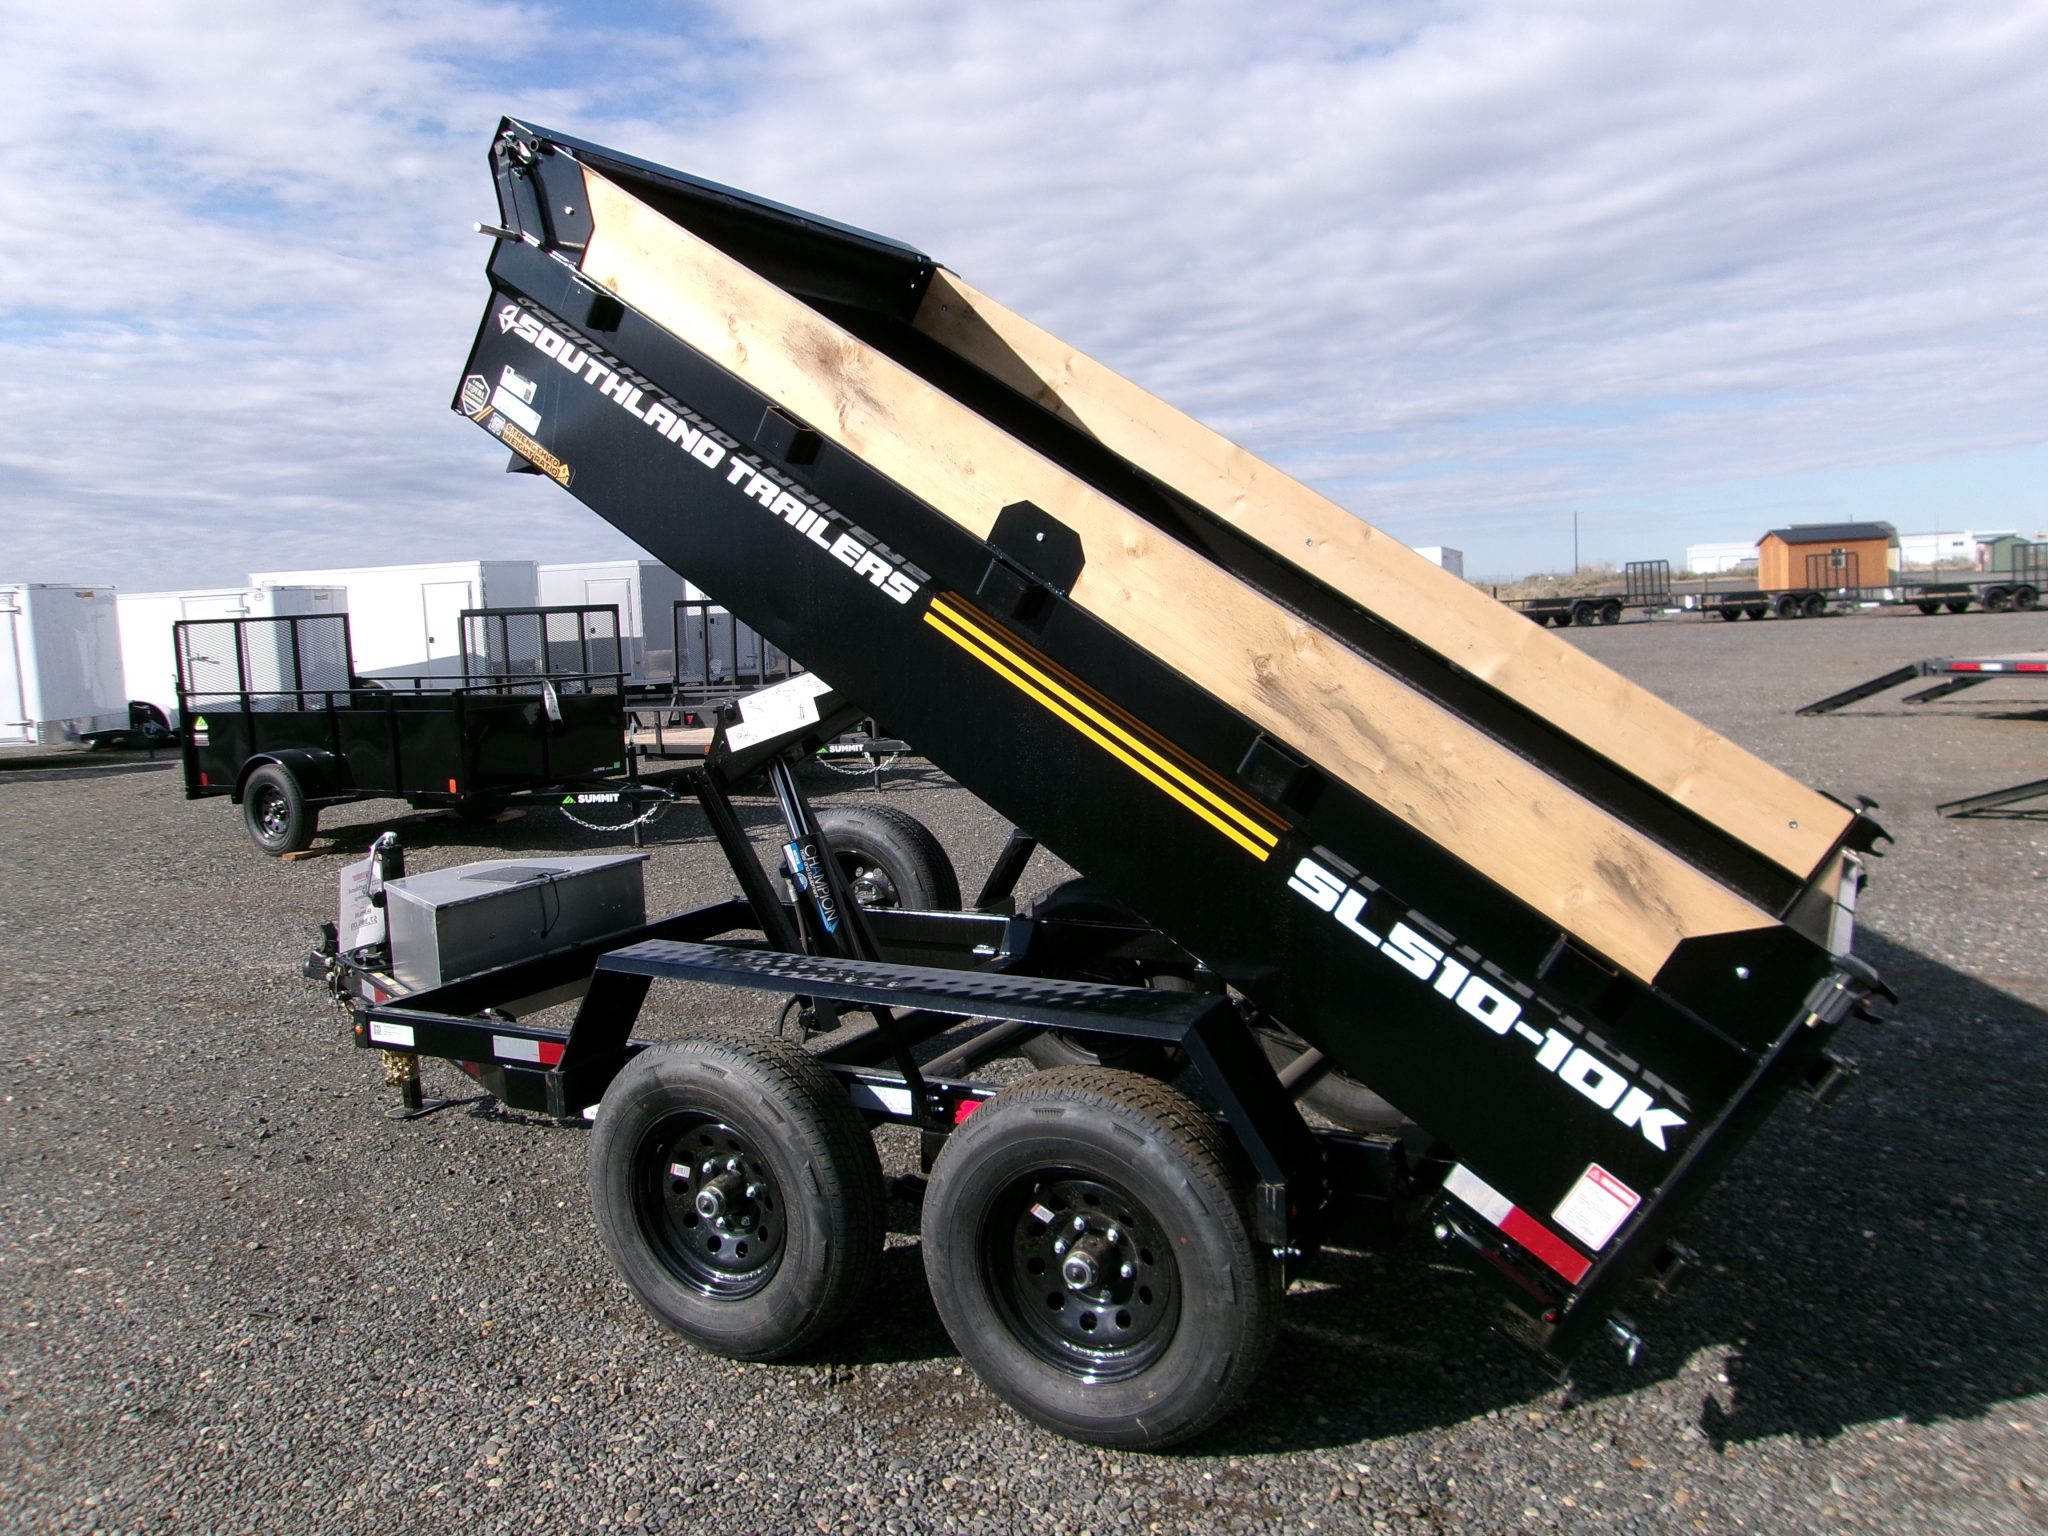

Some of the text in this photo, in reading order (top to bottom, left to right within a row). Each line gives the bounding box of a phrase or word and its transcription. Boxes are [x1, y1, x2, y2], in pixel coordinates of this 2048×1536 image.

[467, 382, 486, 400] TOTAL
[506, 423, 549, 460] STRENGTH
[514, 312, 921, 605] SOUTHLAND TRAILERS
[829, 744, 864, 753] SUMMIT
[577, 793, 620, 804] SUMMIT
[804, 844, 839, 922] CHAMPION
[1287, 857, 1688, 1152] SL510-10K
